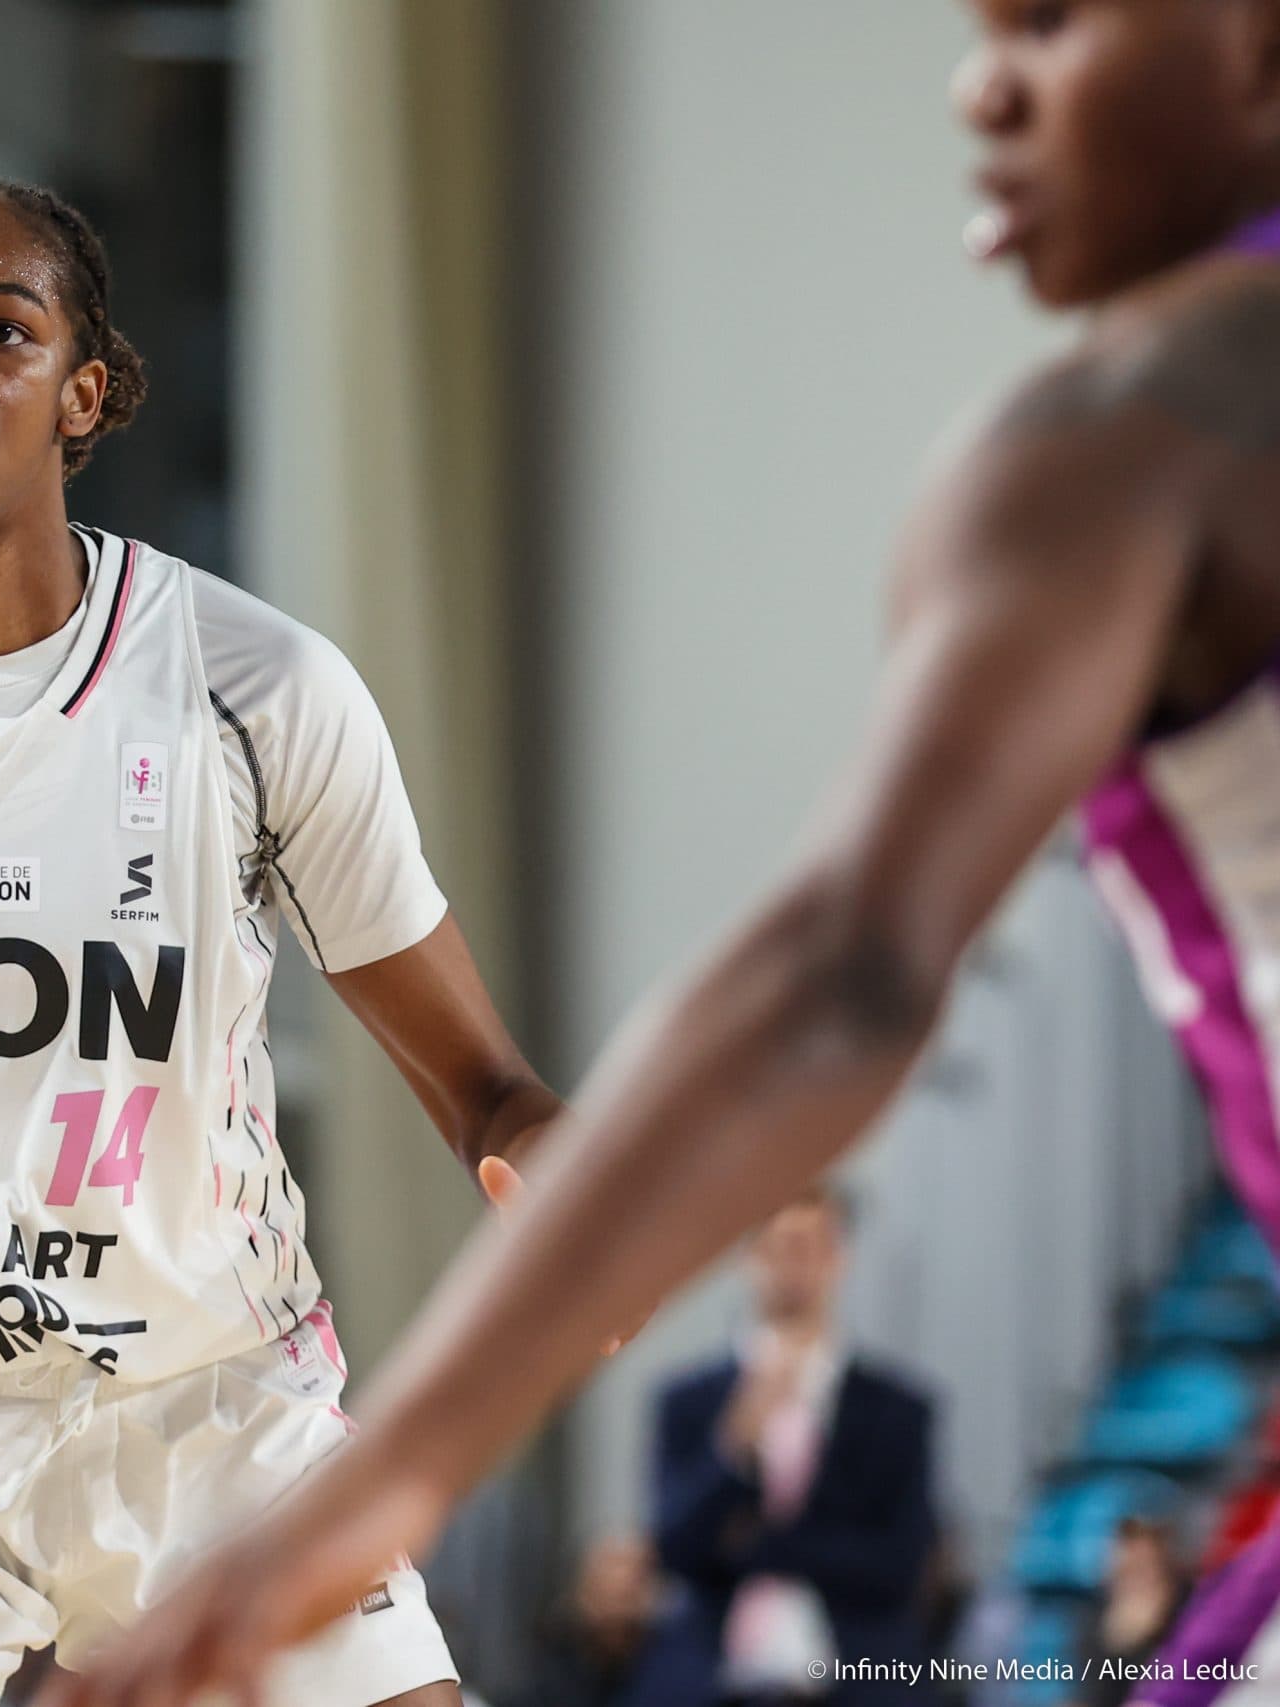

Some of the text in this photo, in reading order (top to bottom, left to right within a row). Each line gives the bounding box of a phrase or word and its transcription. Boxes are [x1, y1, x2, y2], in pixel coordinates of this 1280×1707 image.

[12, 866, 31, 879] DE
[111, 909, 159, 921] SERFIM
[44, 1085, 160, 1206] 14
